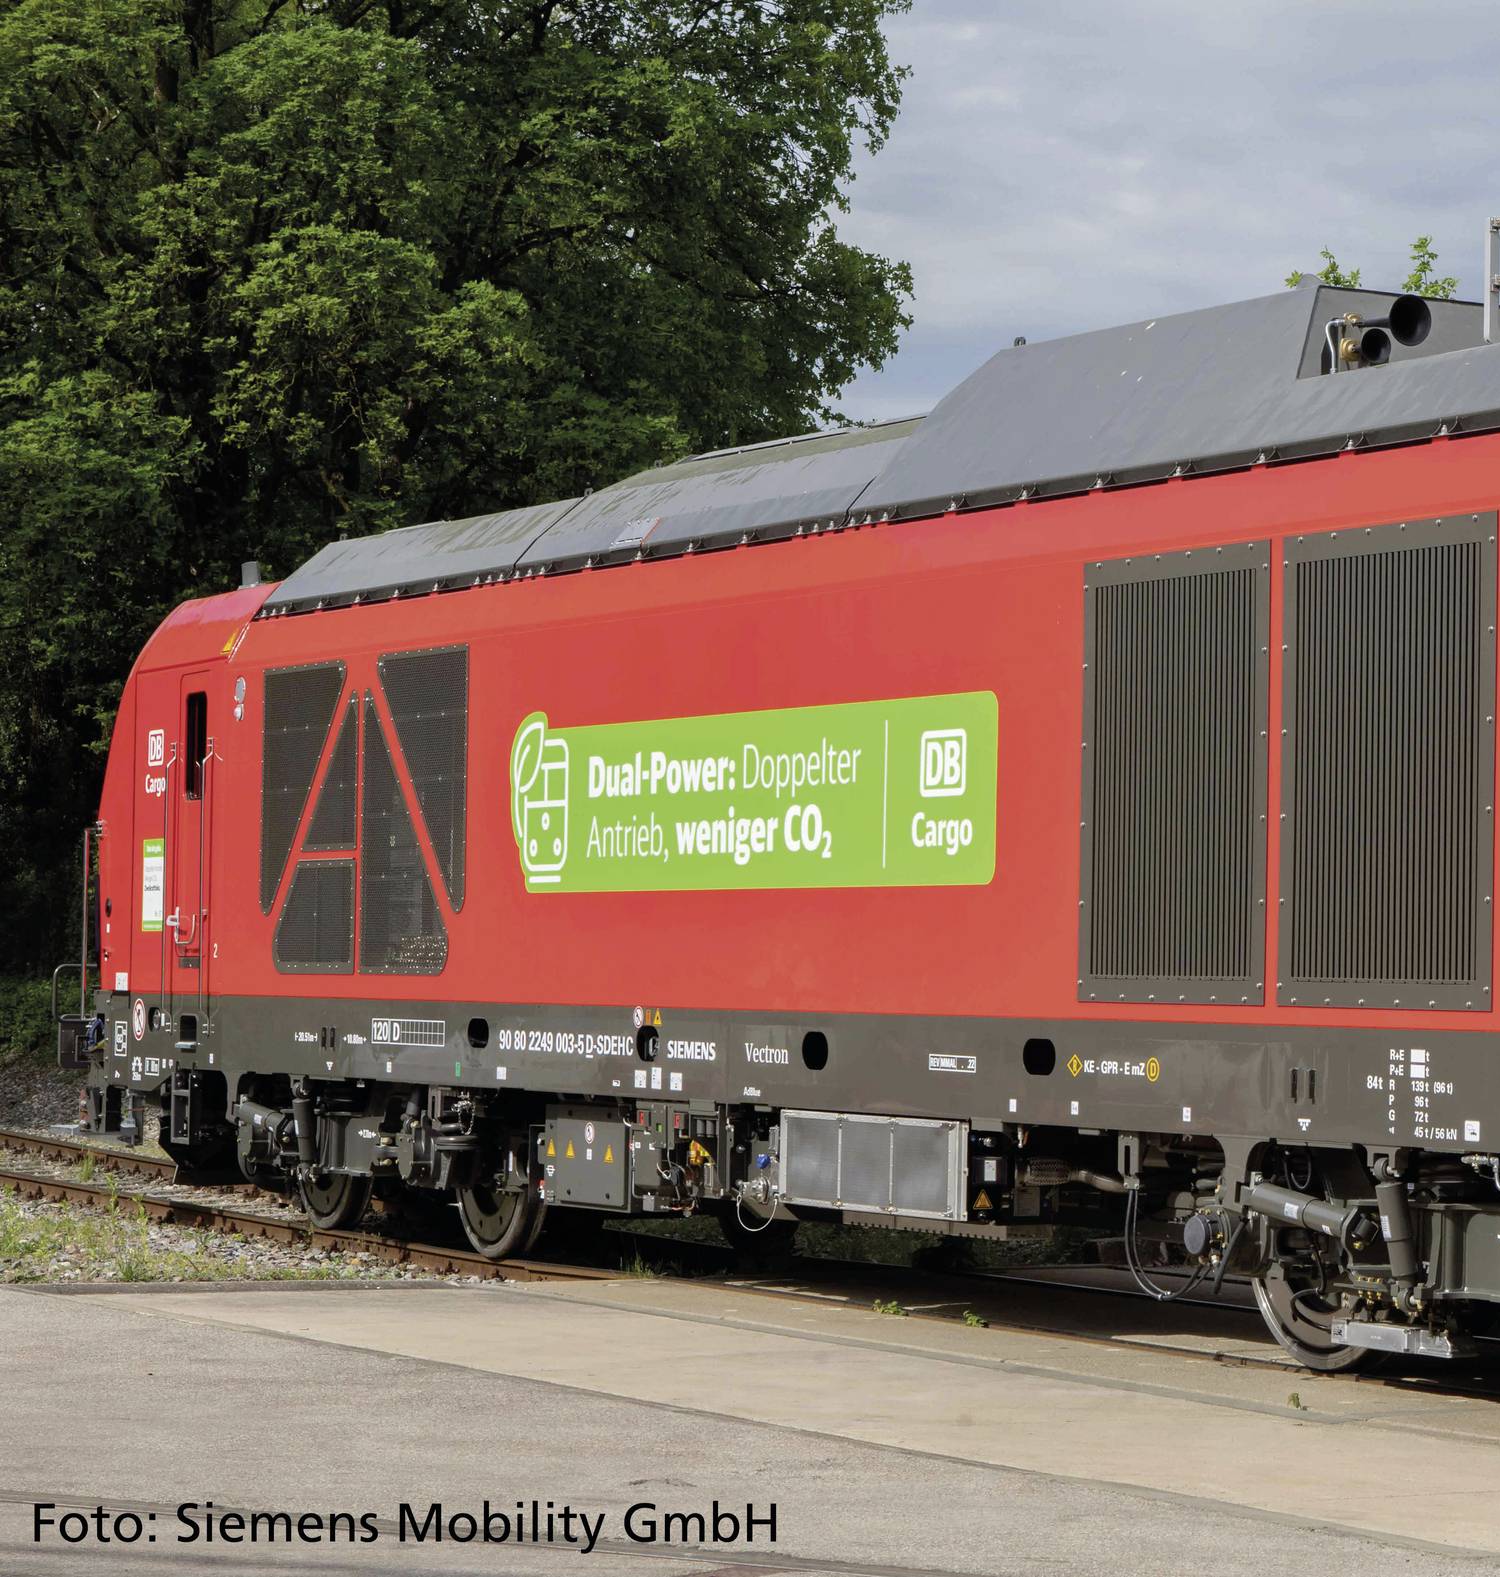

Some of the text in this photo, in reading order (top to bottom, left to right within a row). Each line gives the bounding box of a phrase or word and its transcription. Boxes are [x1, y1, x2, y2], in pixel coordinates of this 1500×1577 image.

[149, 734, 162, 762] DB
[588, 737, 862, 798] Dual-Power: Doppelter
[925, 740, 961, 786] DB
[145, 774, 166, 797] Cargo
[586, 812, 669, 862] Antrieb,
[675, 806, 779, 866] weniger
[912, 812, 973, 856] Cargo
[213, 943, 218, 958] 2
[373, 1021, 401, 1041] 120 D
[499, 1029, 512, 1050] 90
[514, 1030, 526, 1051] 80
[528, 1030, 554, 1053] 2249
[555, 1032, 584, 1055] 003-5
[667, 1040, 716, 1062] SIEMENS
[744, 1042, 790, 1065] Vectron
[1389, 1049, 1405, 1061] R+E
[1083, 1060, 1095, 1073] KE
[1101, 1061, 1118, 1075] GPR
[1389, 1064, 1405, 1076] P+E
[1389, 1079, 1396, 1091] R
[1388, 1094, 1395, 1106] P
[1388, 1109, 1395, 1121] G
